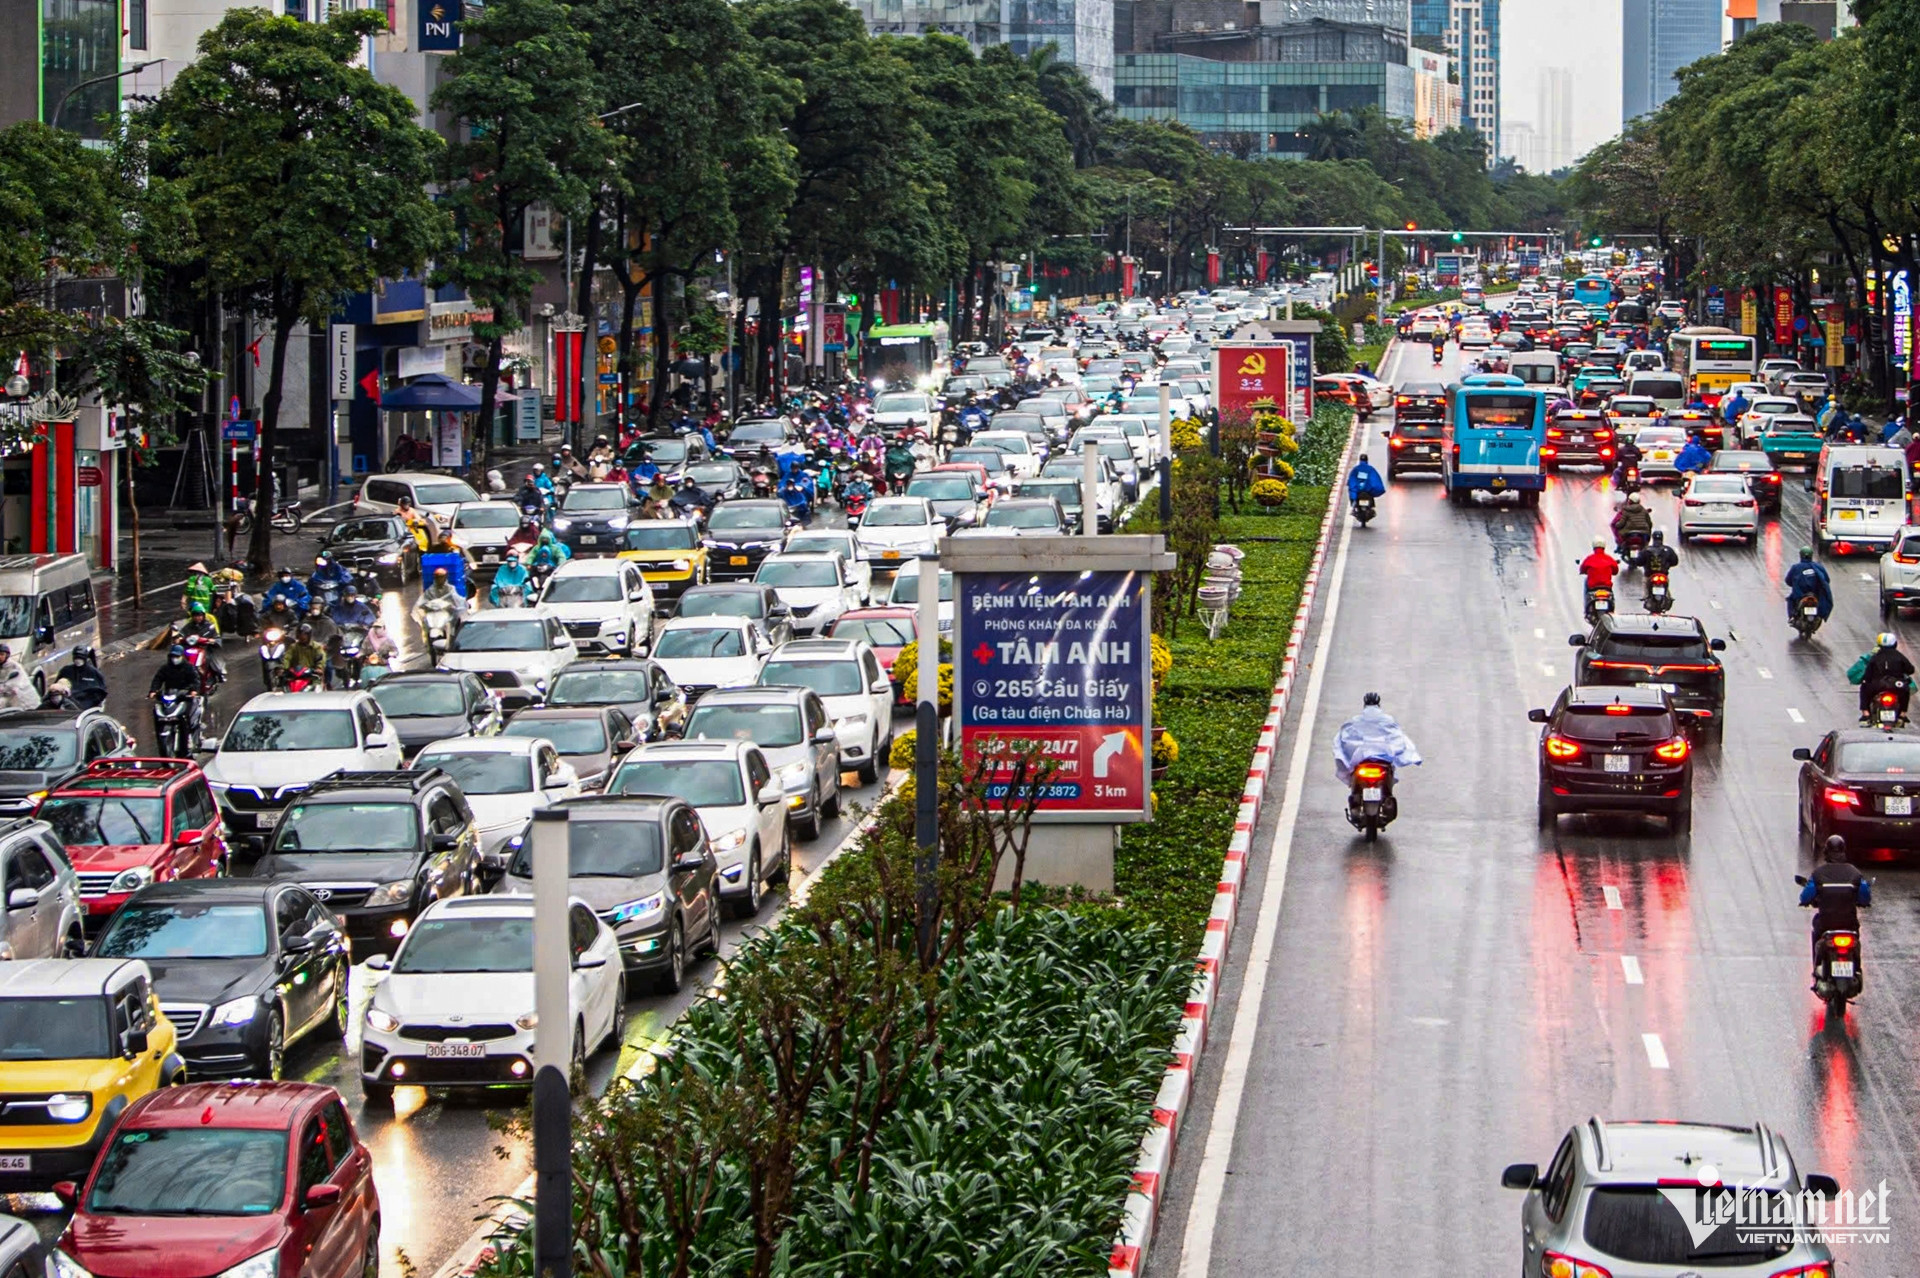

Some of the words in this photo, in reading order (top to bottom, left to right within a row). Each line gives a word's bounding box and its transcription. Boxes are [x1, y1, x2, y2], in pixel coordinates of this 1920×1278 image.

[425, 22, 450, 38] PNJ
[339, 331, 347, 394] ELISE
[1241, 378, 1262, 387] 3-2
[972, 592, 1014, 612] BỆNH
[1018, 592, 1056, 612] VIỆN
[985, 618, 1025, 631] PHÒNG
[1029, 618, 1063, 631] KHÁM
[1066, 620, 1082, 630] ĐA
[997, 637, 1060, 665] TÂM
[1066, 641, 1131, 665] ANH
[995, 680, 1034, 698] 265
[1039, 677, 1079, 698] Cầu
[1084, 677, 1130, 701] Giấy
[972, 705, 998, 721] (Ga
[1001, 706, 1025, 720] tàu
[1028, 705, 1061, 723] điện
[1105, 704, 1131, 720] Hà)
[1042, 740, 1079, 754] 24/7
[1048, 785, 1077, 798] 3872
[1094, 785, 1103, 797] 3
[1105, 785, 1127, 797] km
[428, 1045, 484, 1057] 30G-348.07
